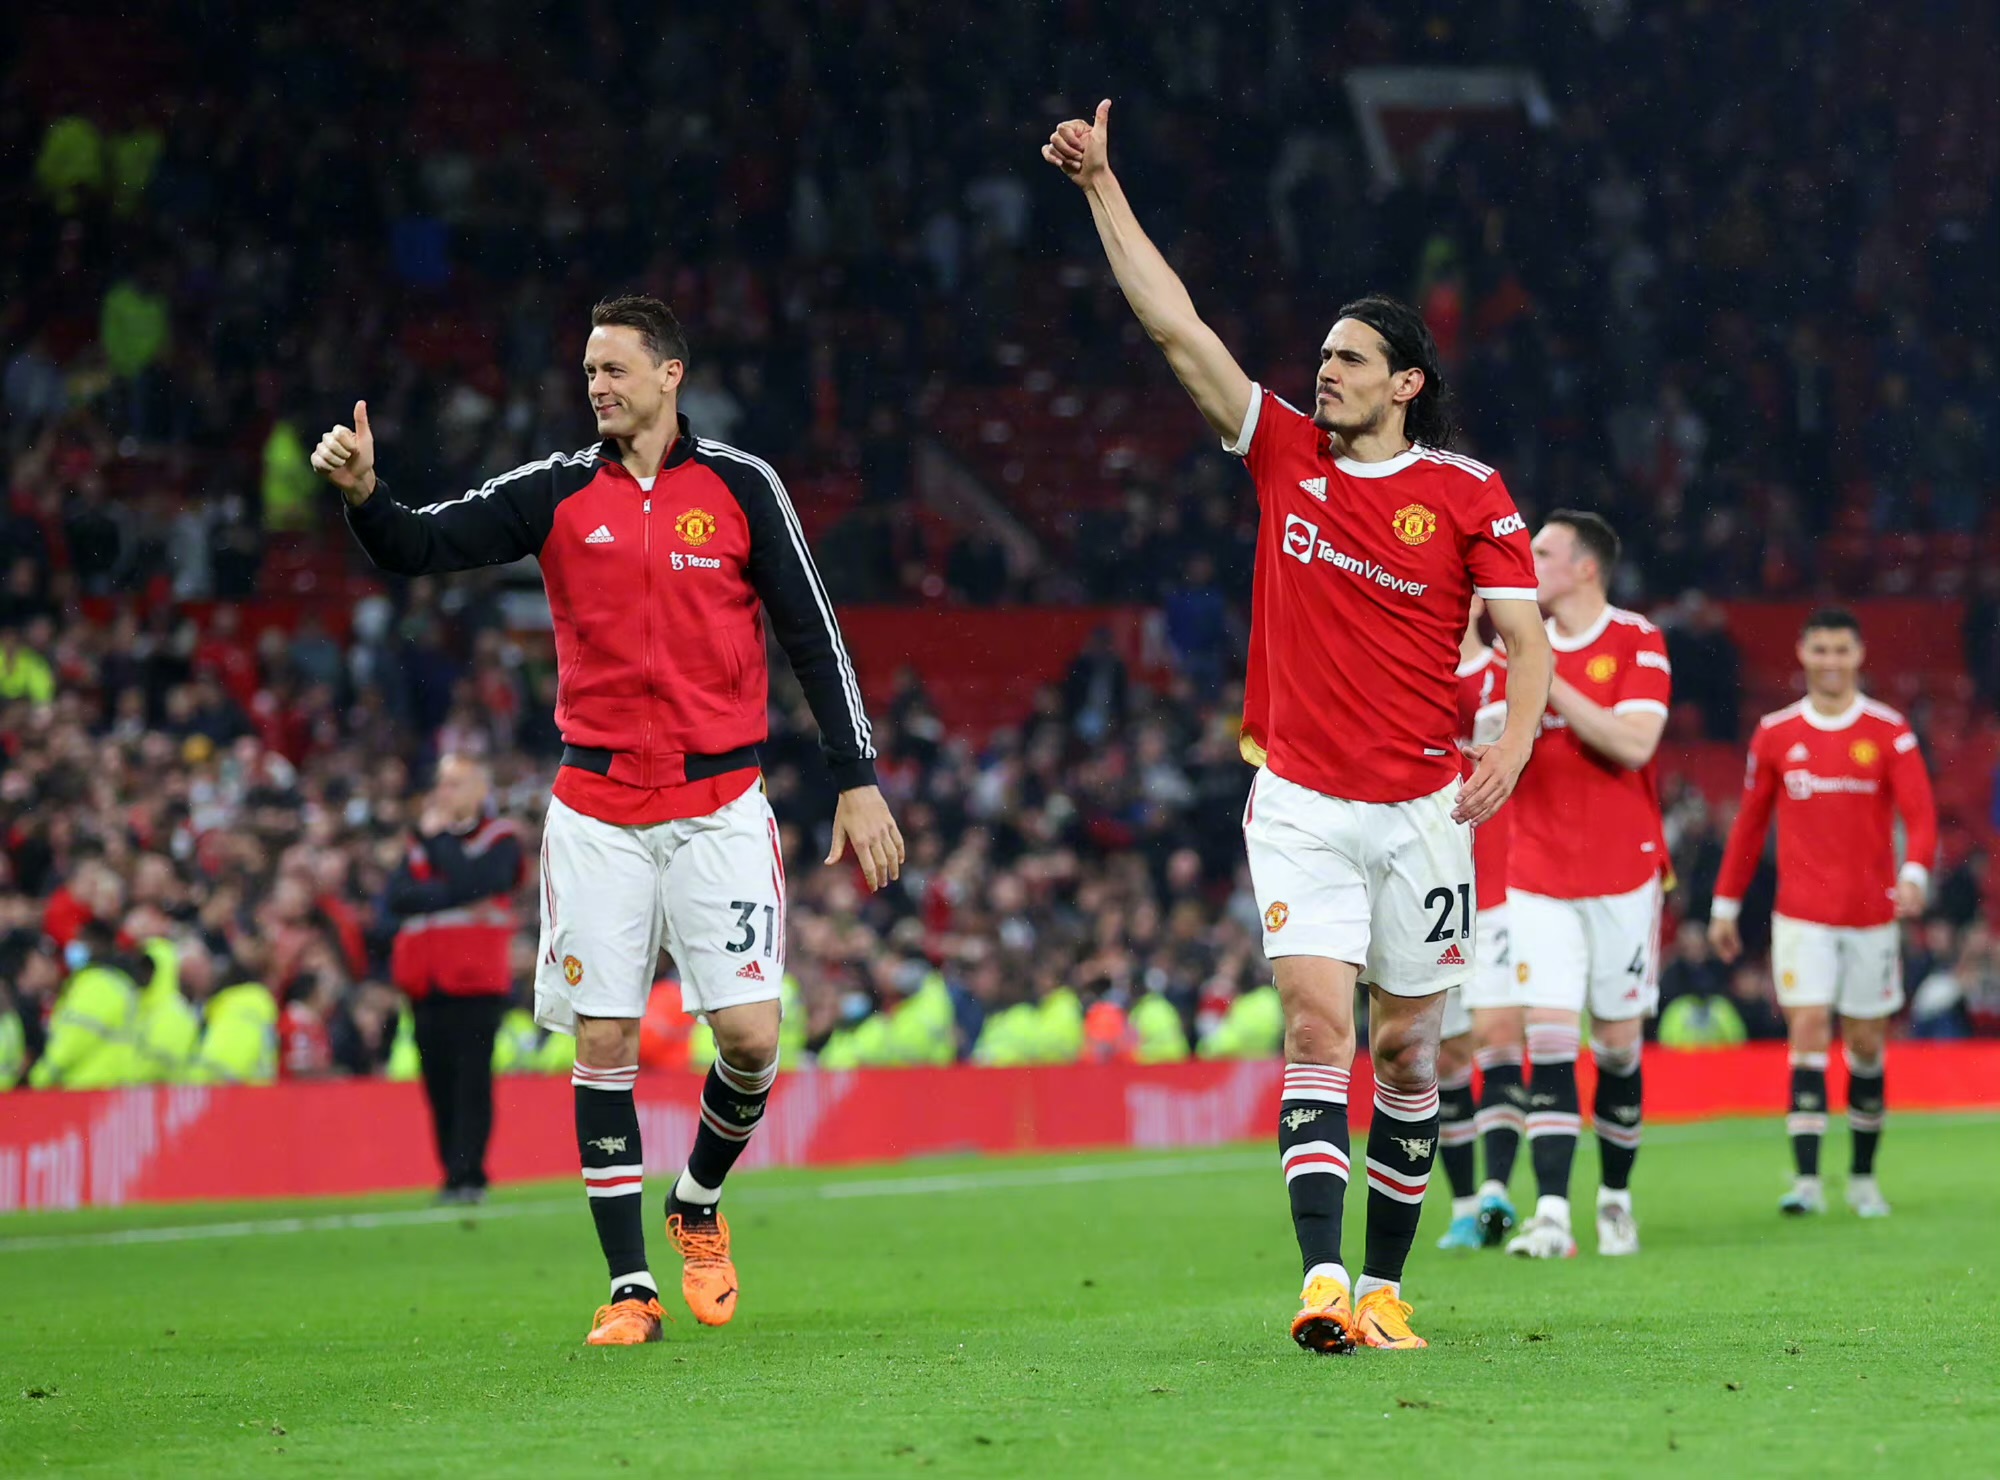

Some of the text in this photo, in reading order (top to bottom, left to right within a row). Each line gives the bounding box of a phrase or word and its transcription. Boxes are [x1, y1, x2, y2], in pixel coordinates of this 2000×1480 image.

[1299, 480, 1328, 502] adidas
[585, 536, 615, 544] adidas
[684, 554, 721, 569] Tezos
[1316, 538, 1428, 597] TeamViewer
[1424, 883, 1470, 943] 21
[725, 900, 775, 958] 31
[1437, 956, 1465, 964] adidas
[736, 970, 764, 981] adidas
